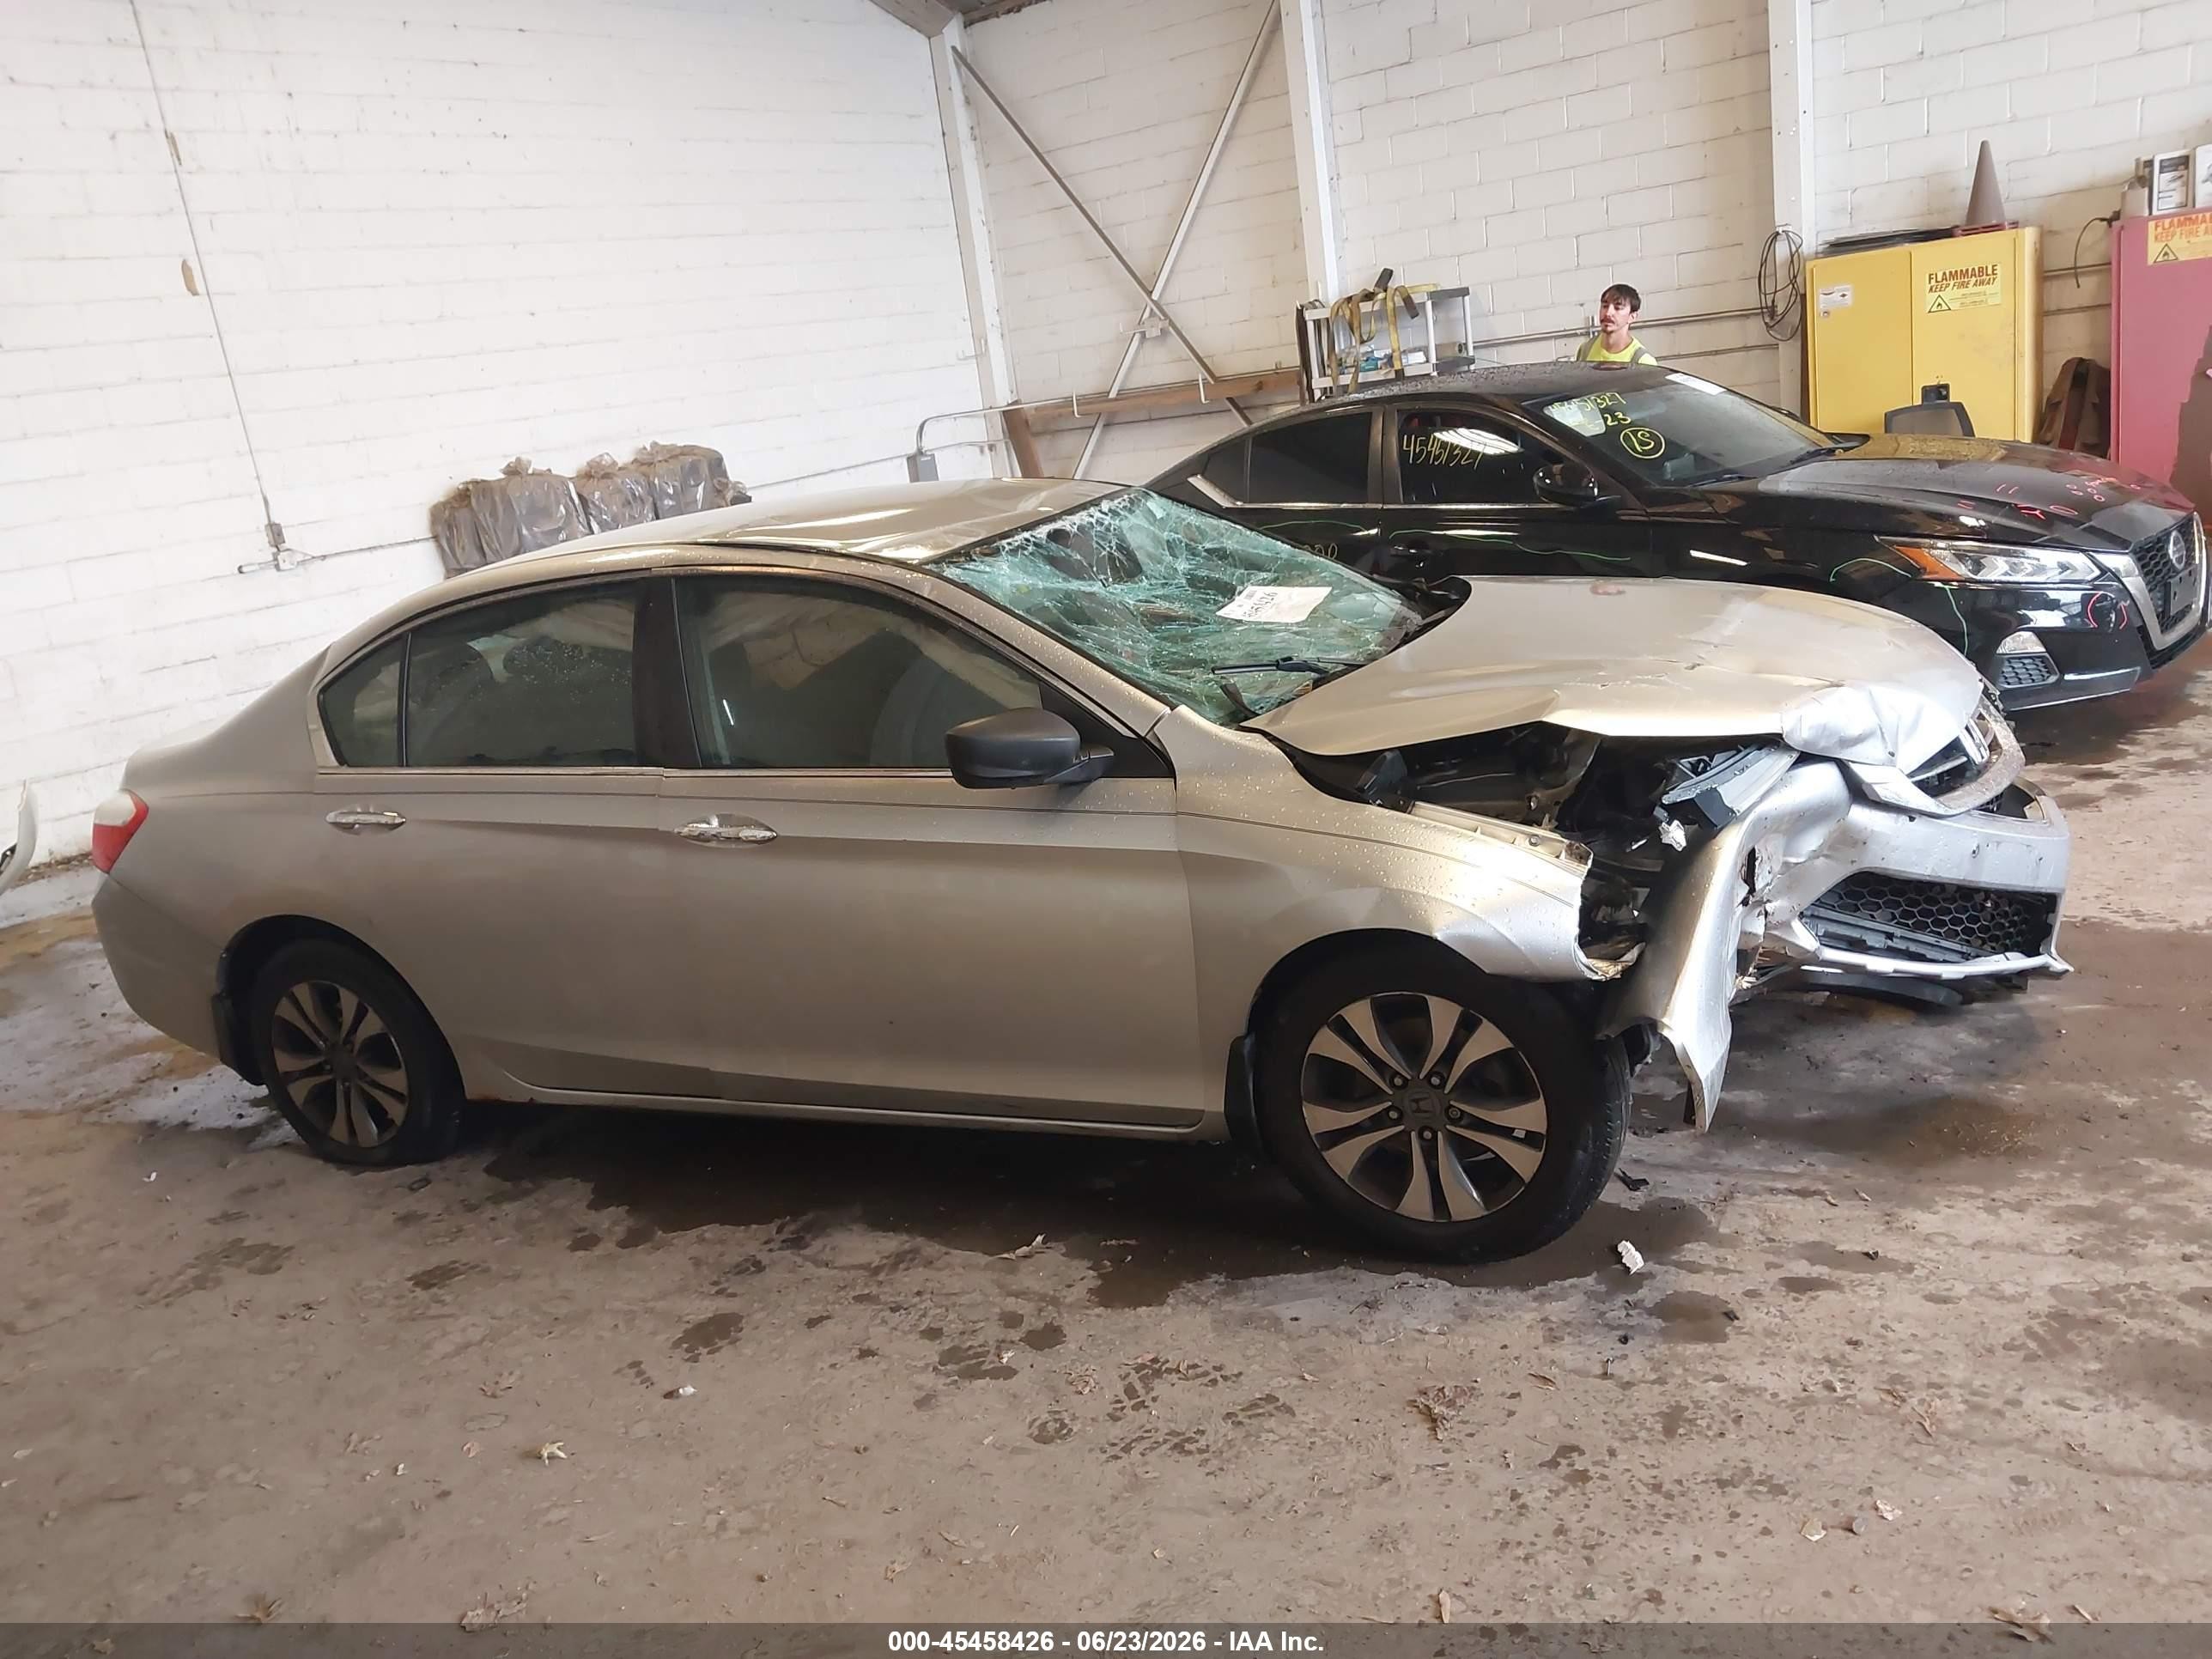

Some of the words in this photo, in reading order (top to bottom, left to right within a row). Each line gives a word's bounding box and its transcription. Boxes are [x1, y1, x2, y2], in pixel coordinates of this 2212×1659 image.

[2179, 227, 2201, 240] FIRE
[1928, 264, 1998, 284] FLAMMABLE
[1929, 283, 1950, 294] KEEP
[1952, 280, 1972, 290] FIRE
[1972, 276, 1997, 288] AWAY
